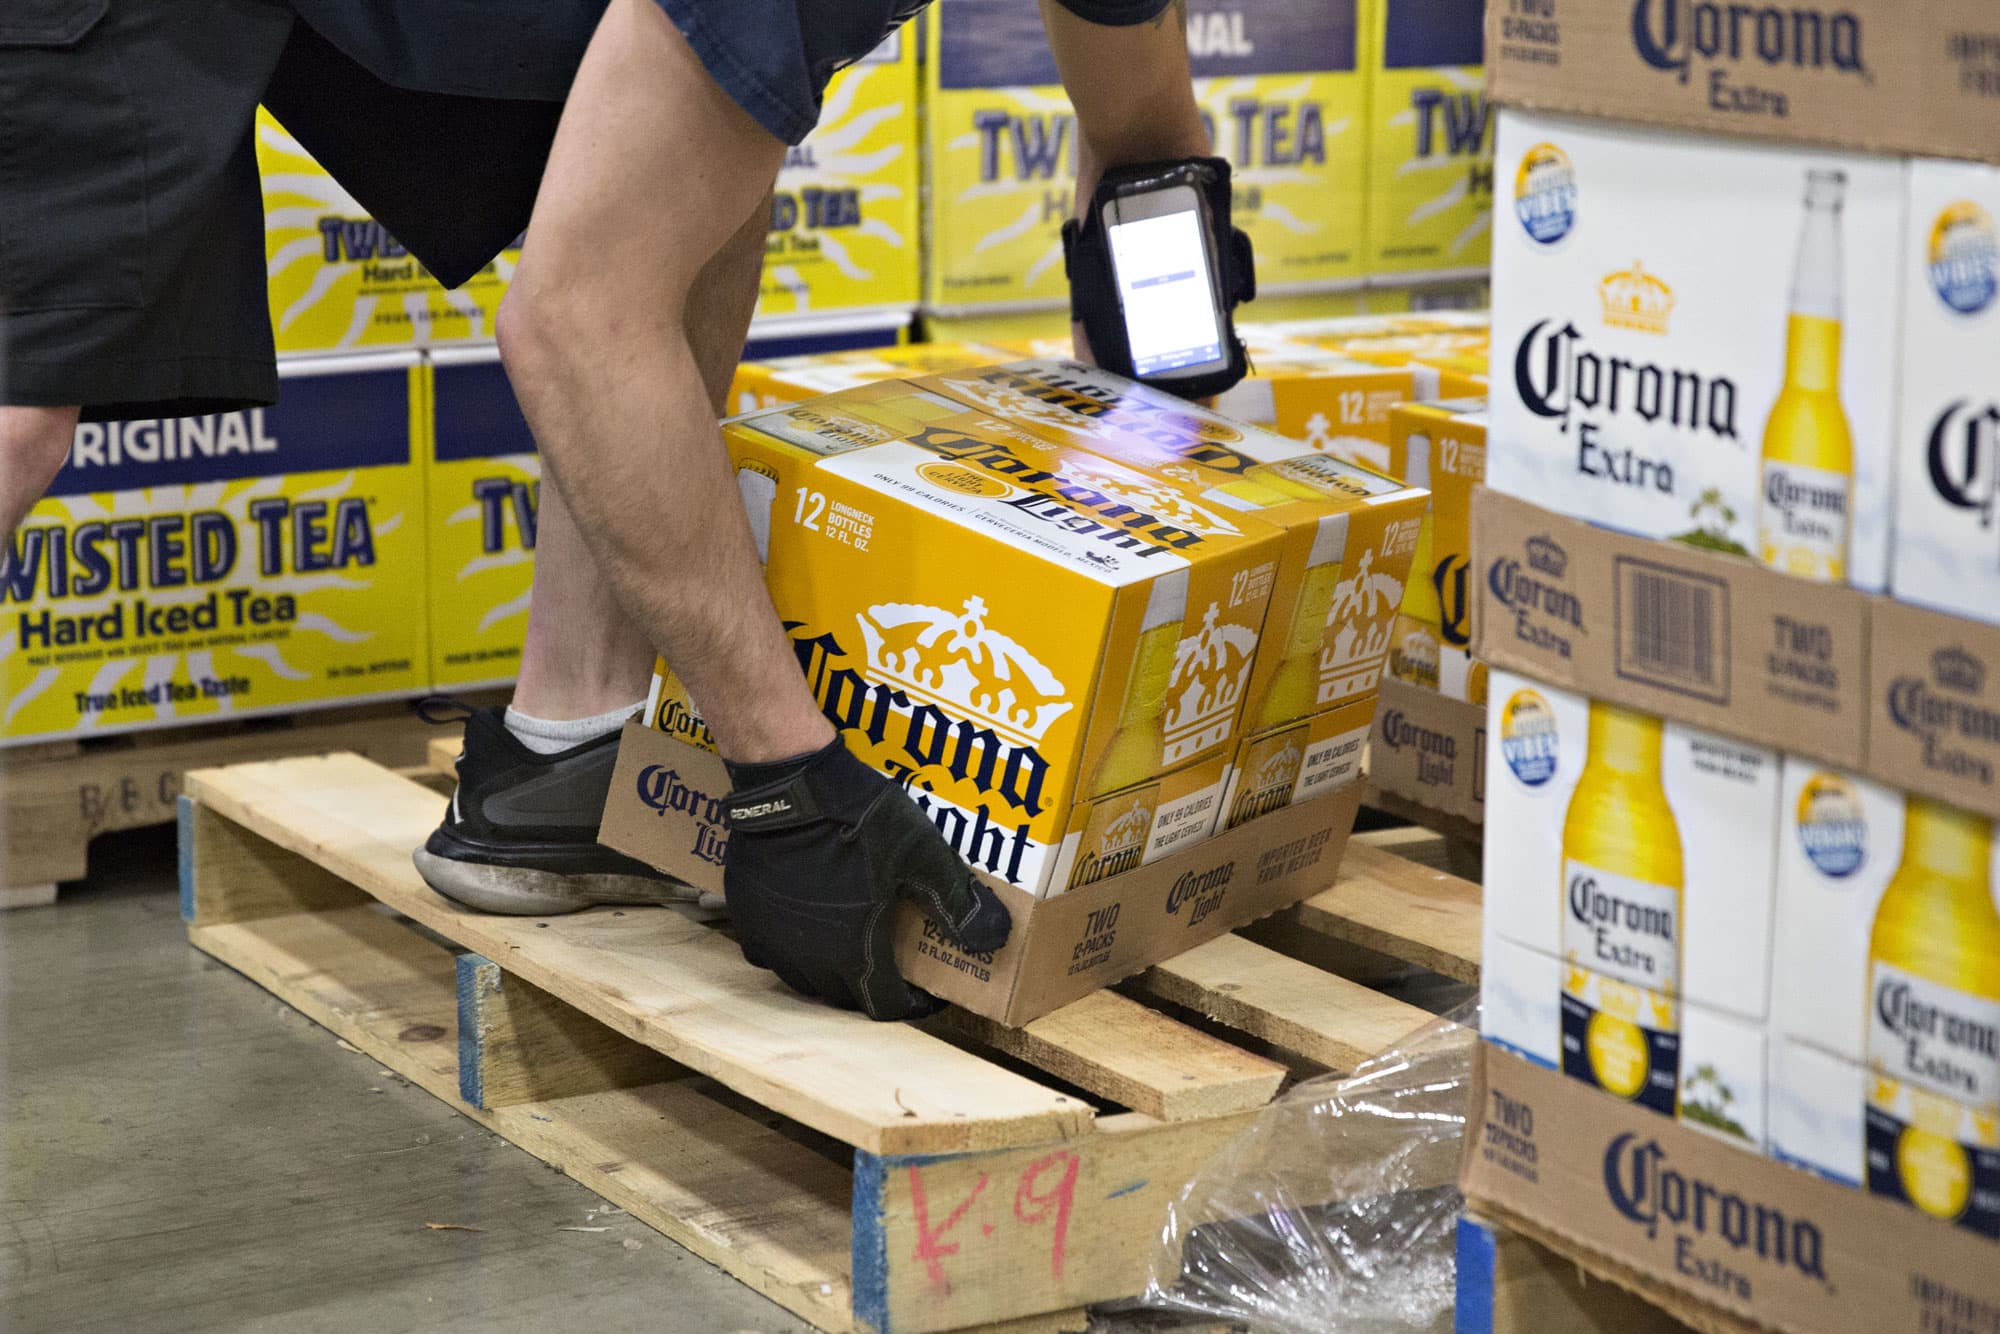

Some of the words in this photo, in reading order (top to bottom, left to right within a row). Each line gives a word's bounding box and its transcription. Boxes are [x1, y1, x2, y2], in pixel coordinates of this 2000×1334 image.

[1710, 70, 1790, 118] Extra
[1231, 100, 1327, 168] TEA
[802, 186, 860, 230] TEA
[1513, 318, 1742, 440] Corona
[1335, 391, 1365, 425] 12
[65, 411, 277, 468] RIGINAL
[1439, 437, 1459, 473] 12
[1577, 423, 1676, 495] Extra
[793, 486, 826, 532] 12
[873, 472, 902, 486] ONLY
[915, 490, 966, 512] CALORIES
[904, 426, 1206, 549] Corona
[827, 511, 872, 539] BOTTLES
[830, 500, 874, 526] LONGNECK
[974, 513, 1032, 541] CERVECERIA
[997, 488, 1172, 558] Light
[251, 496, 377, 580] TEA
[824, 525, 836, 539] 12
[837, 530, 852, 545] FL.
[853, 537, 870, 553] OZ.
[1381, 521, 1400, 557] 12
[1229, 568, 1249, 608] 12
[1488, 556, 1587, 637] Corona
[19, 606, 123, 650] Hard
[136, 594, 219, 637] Iced
[227, 590, 298, 624] Tea
[1514, 611, 1572, 660] Extra
[75, 691, 117, 713] True
[121, 682, 160, 707] Iced
[164, 681, 197, 702] Tea
[200, 674, 250, 700] Taste
[1308, 751, 1323, 768] ONLY
[1331, 739, 1359, 757] CALORIES
[1382, 709, 1458, 760] Corona
[1304, 773, 1316, 787] THE
[1157, 811, 1174, 829] ONLY
[1183, 796, 1213, 817] CALORIES
[1155, 835, 1166, 849] THE
[1165, 828, 1181, 845] LIGHT
[1166, 861, 1234, 915] Corona
[1186, 886, 1226, 928] Light
[1569, 872, 1677, 942] Corona
[1084, 903, 1120, 937] TWO
[918, 940, 929, 954] 12
[953, 956, 991, 982] BOTTLES
[1072, 930, 1116, 960] 12-PACKS
[1594, 927, 1656, 975] Extra
[1492, 1089, 1534, 1137] TWO
[1603, 1131, 1828, 1282] Corona
[1675, 1233, 1753, 1302] Extra
